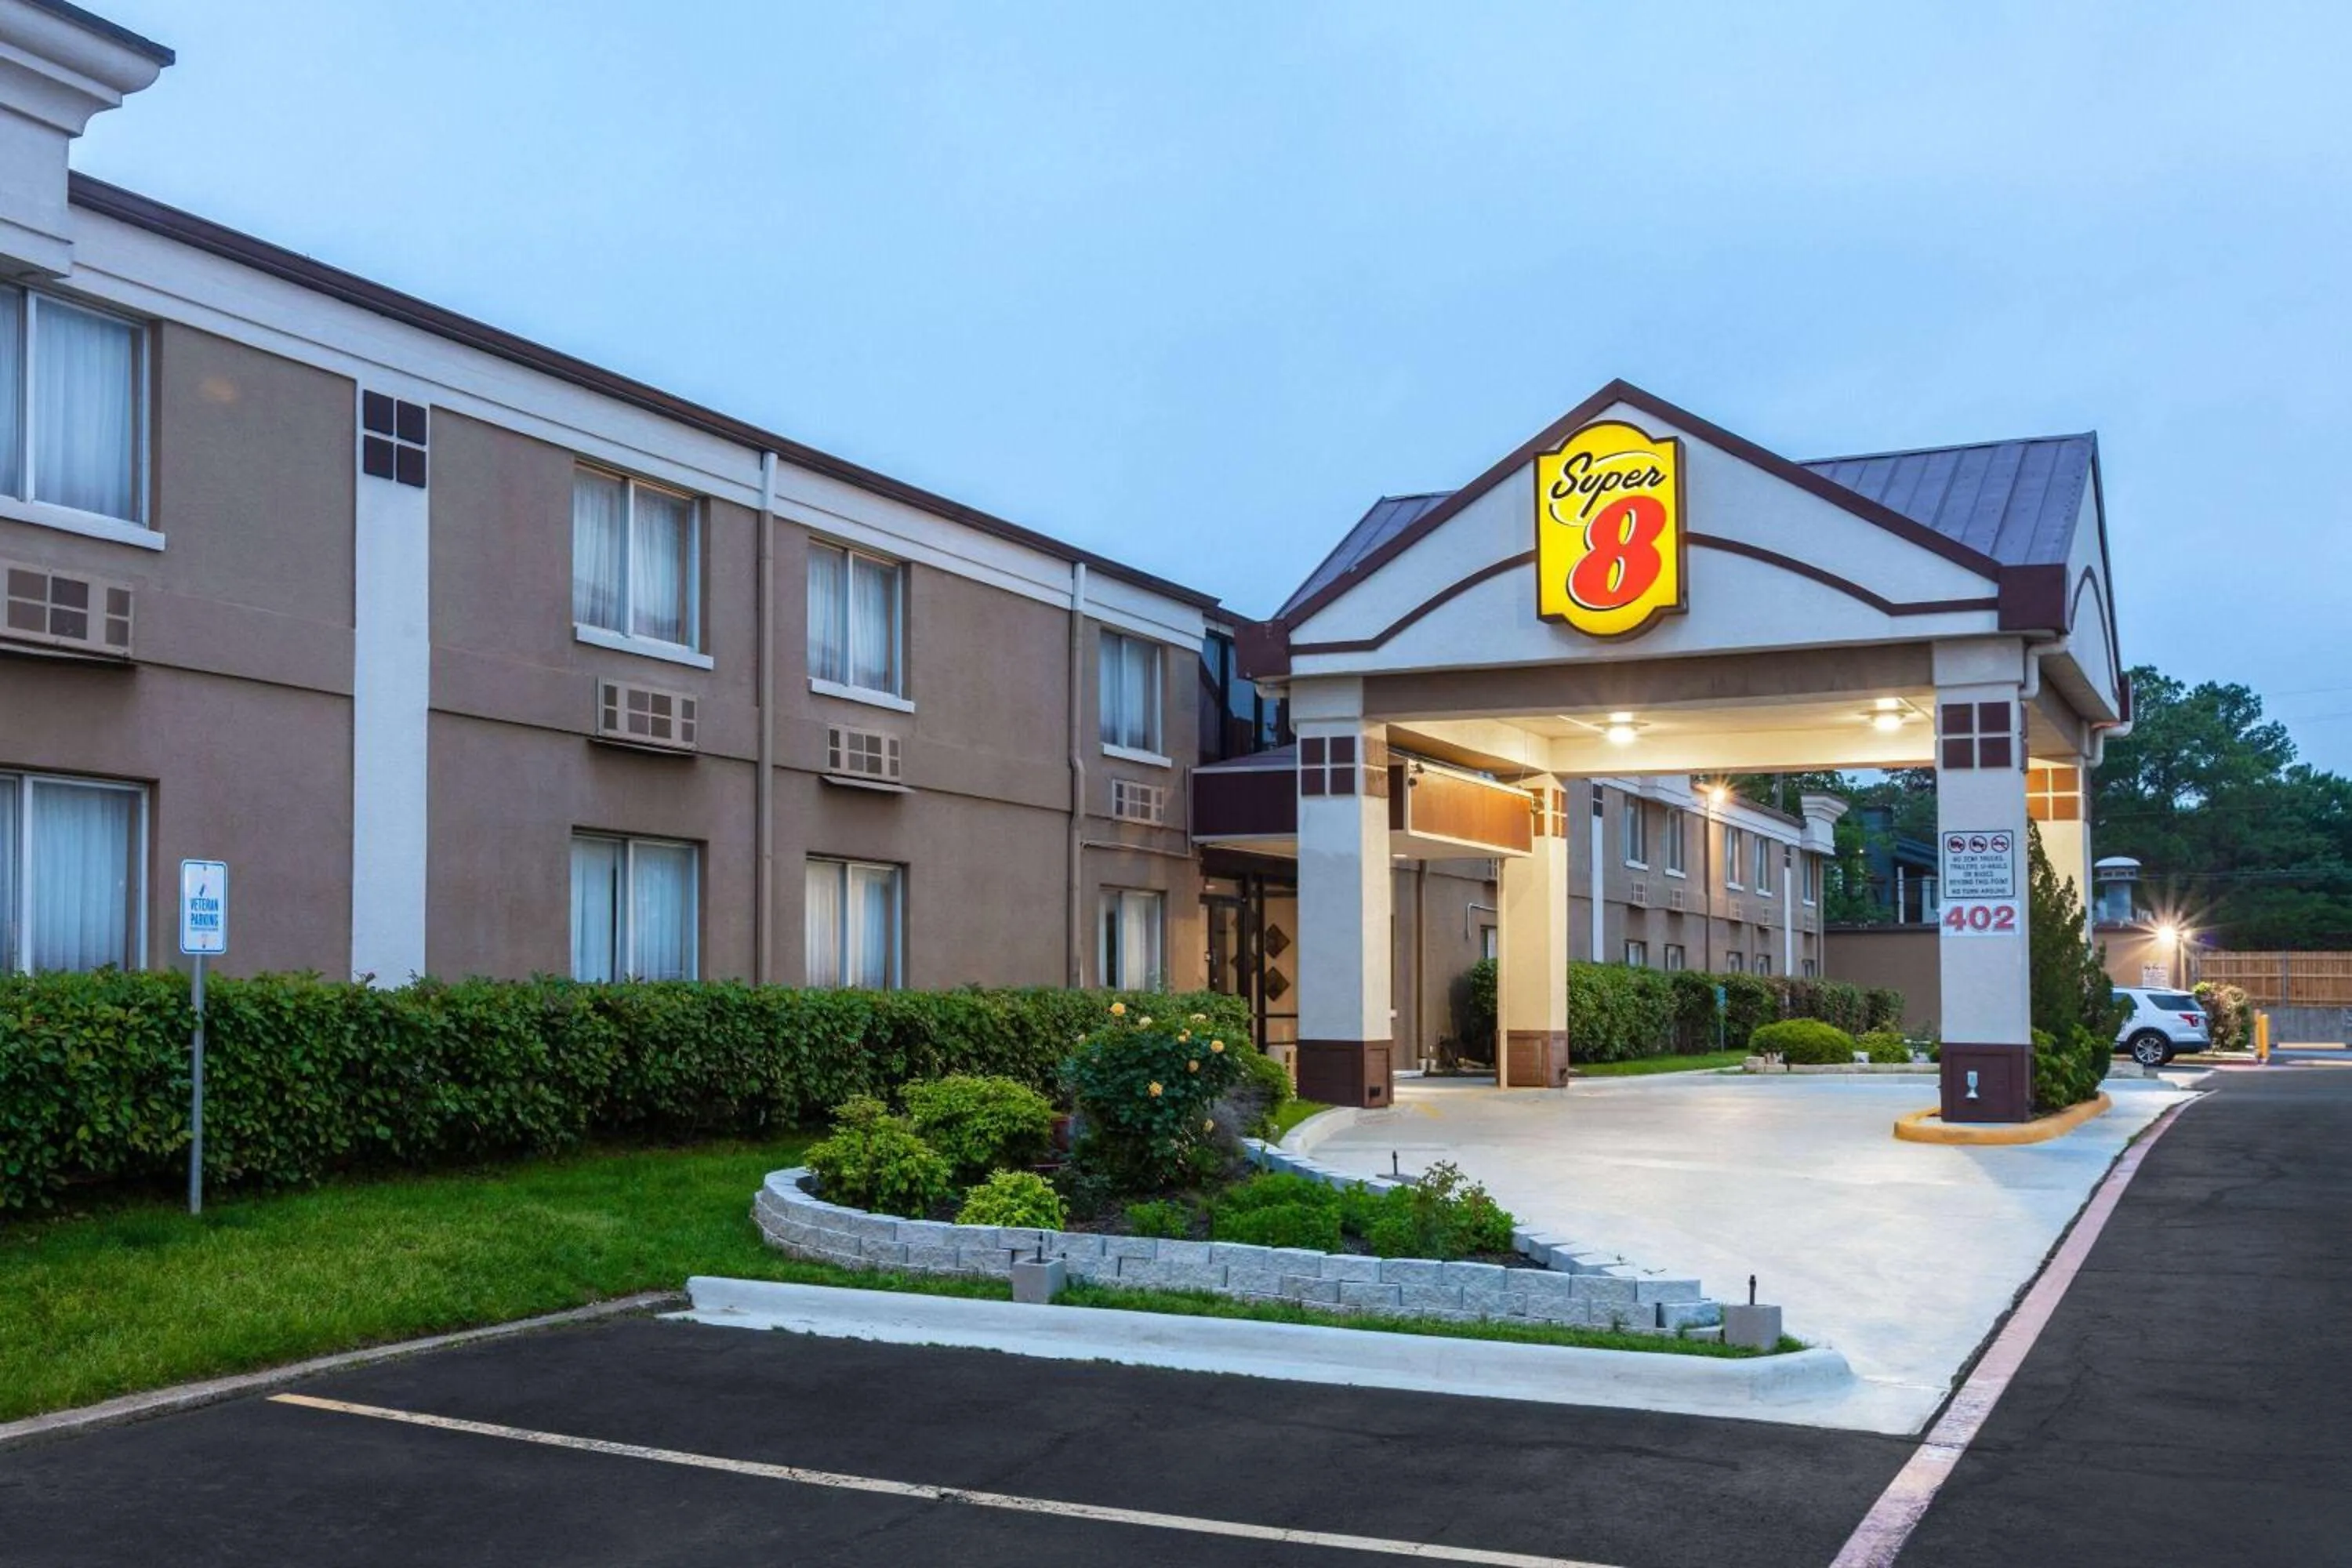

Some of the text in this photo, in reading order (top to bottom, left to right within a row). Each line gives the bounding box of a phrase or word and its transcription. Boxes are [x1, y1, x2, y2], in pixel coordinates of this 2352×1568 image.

[1550, 451, 1667, 520] Super
[1566, 495, 1667, 612] 8
[191, 898, 219, 912] VETERAN
[191, 913, 219, 927] PARKING
[1944, 906, 2015, 931] 402
